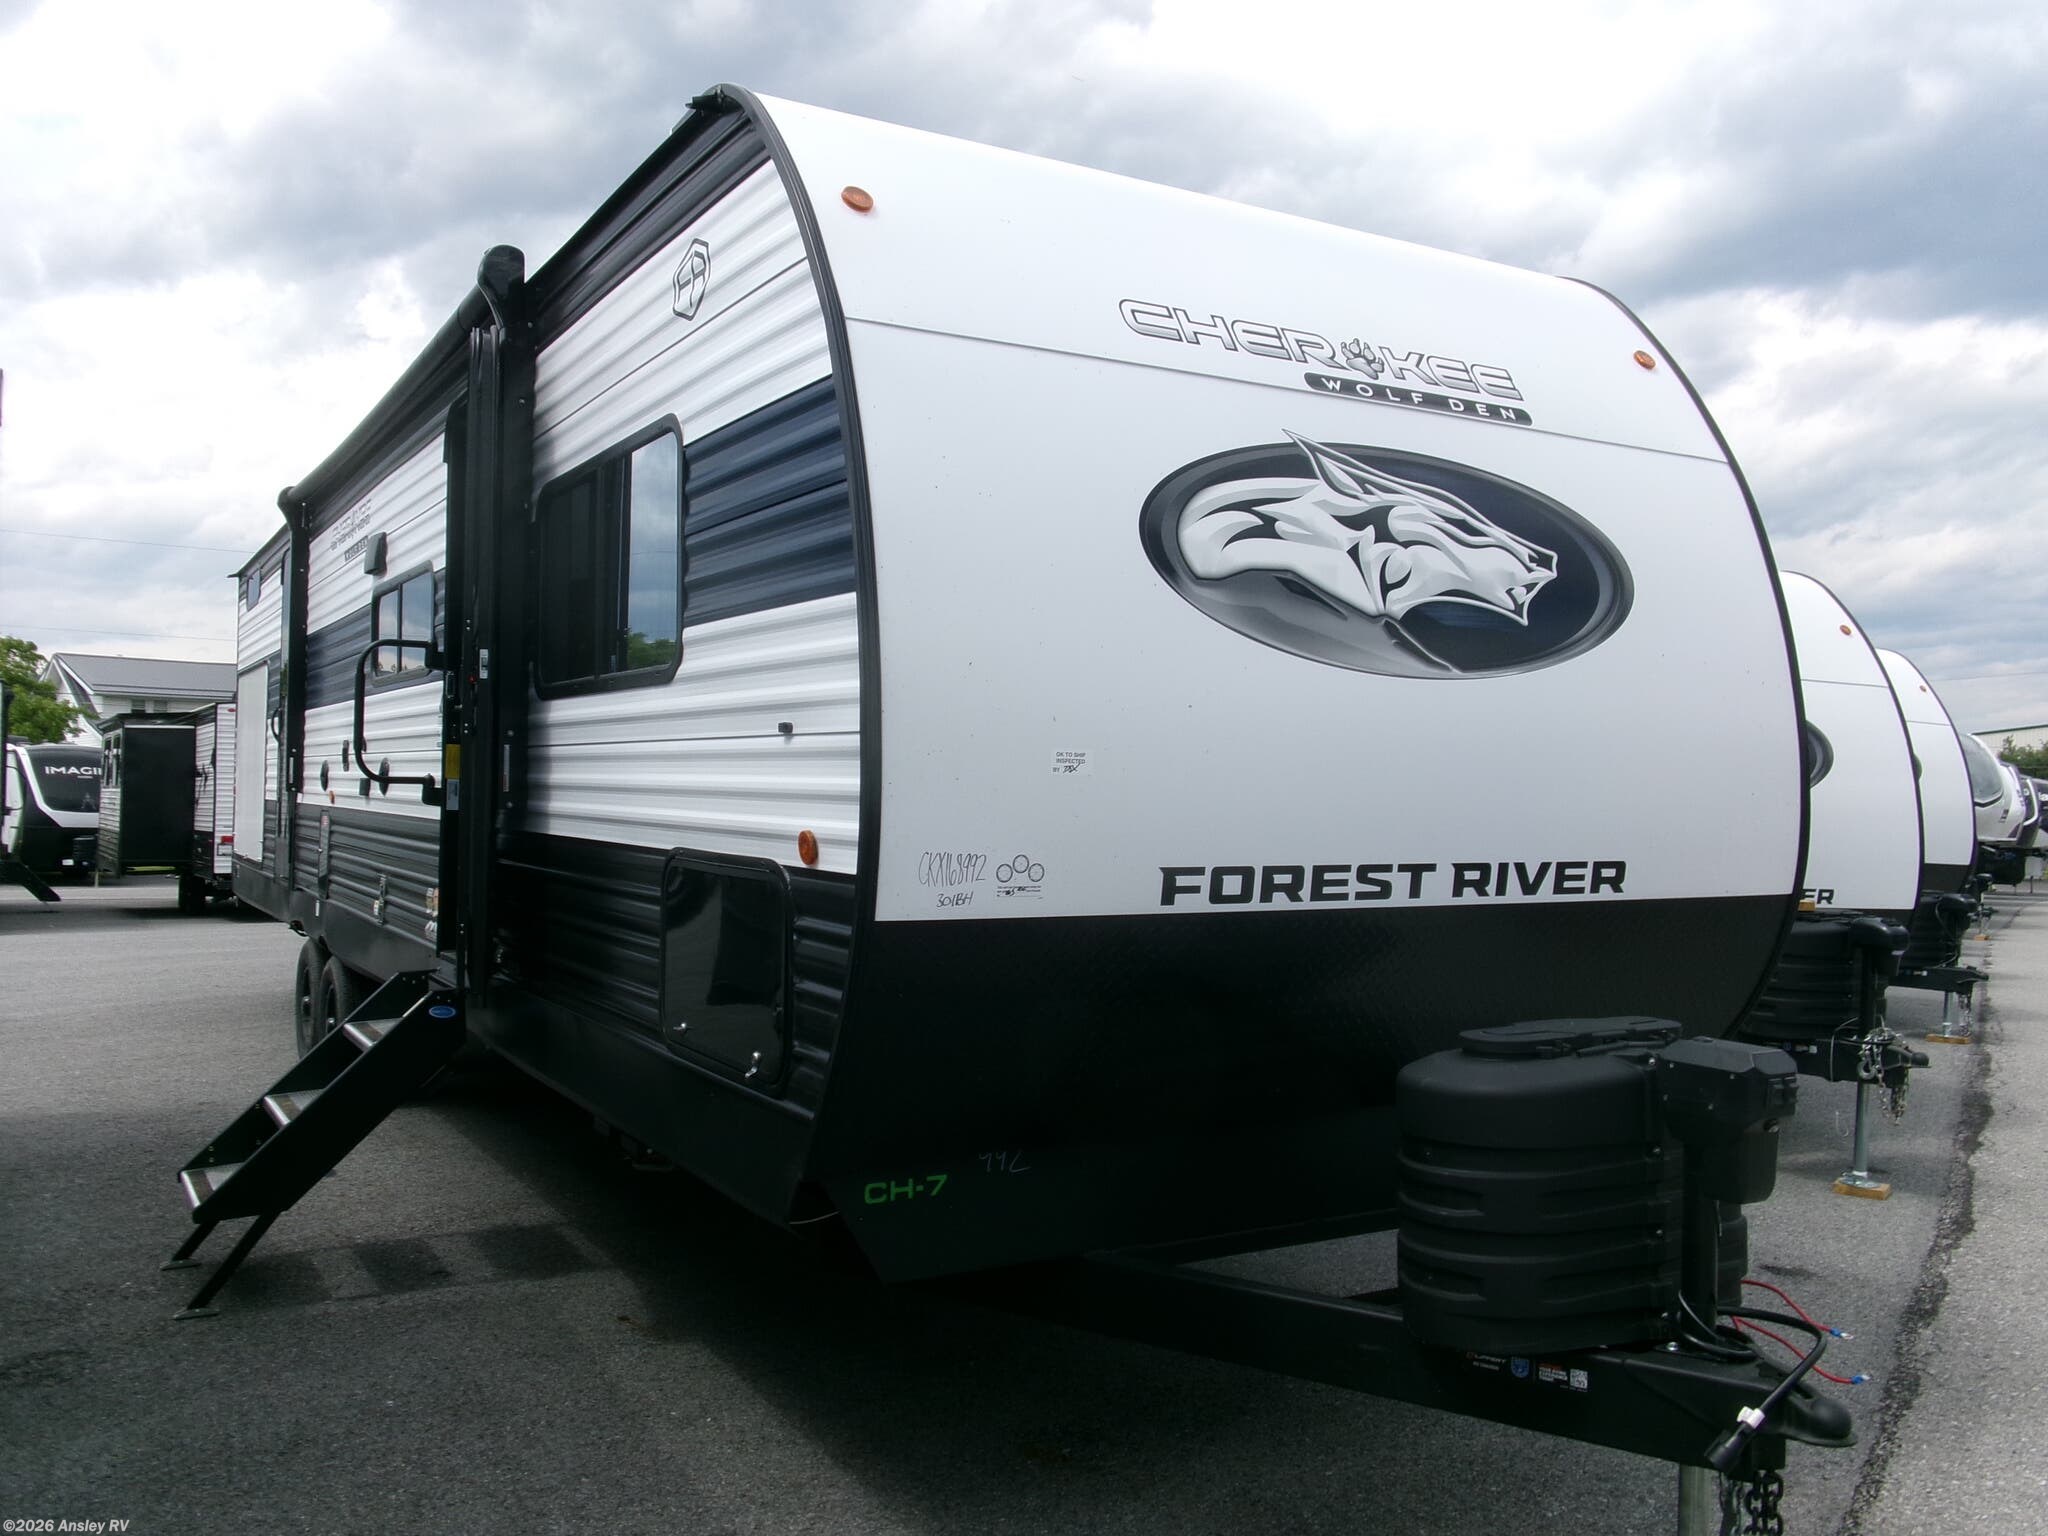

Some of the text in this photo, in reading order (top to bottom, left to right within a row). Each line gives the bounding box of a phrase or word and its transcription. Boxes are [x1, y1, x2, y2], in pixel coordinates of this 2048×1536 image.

[1320, 376, 1517, 421] WOLF DEN
[1158, 860, 1628, 906] FOREST RIVER
[864, 1174, 948, 1205] CH-7
